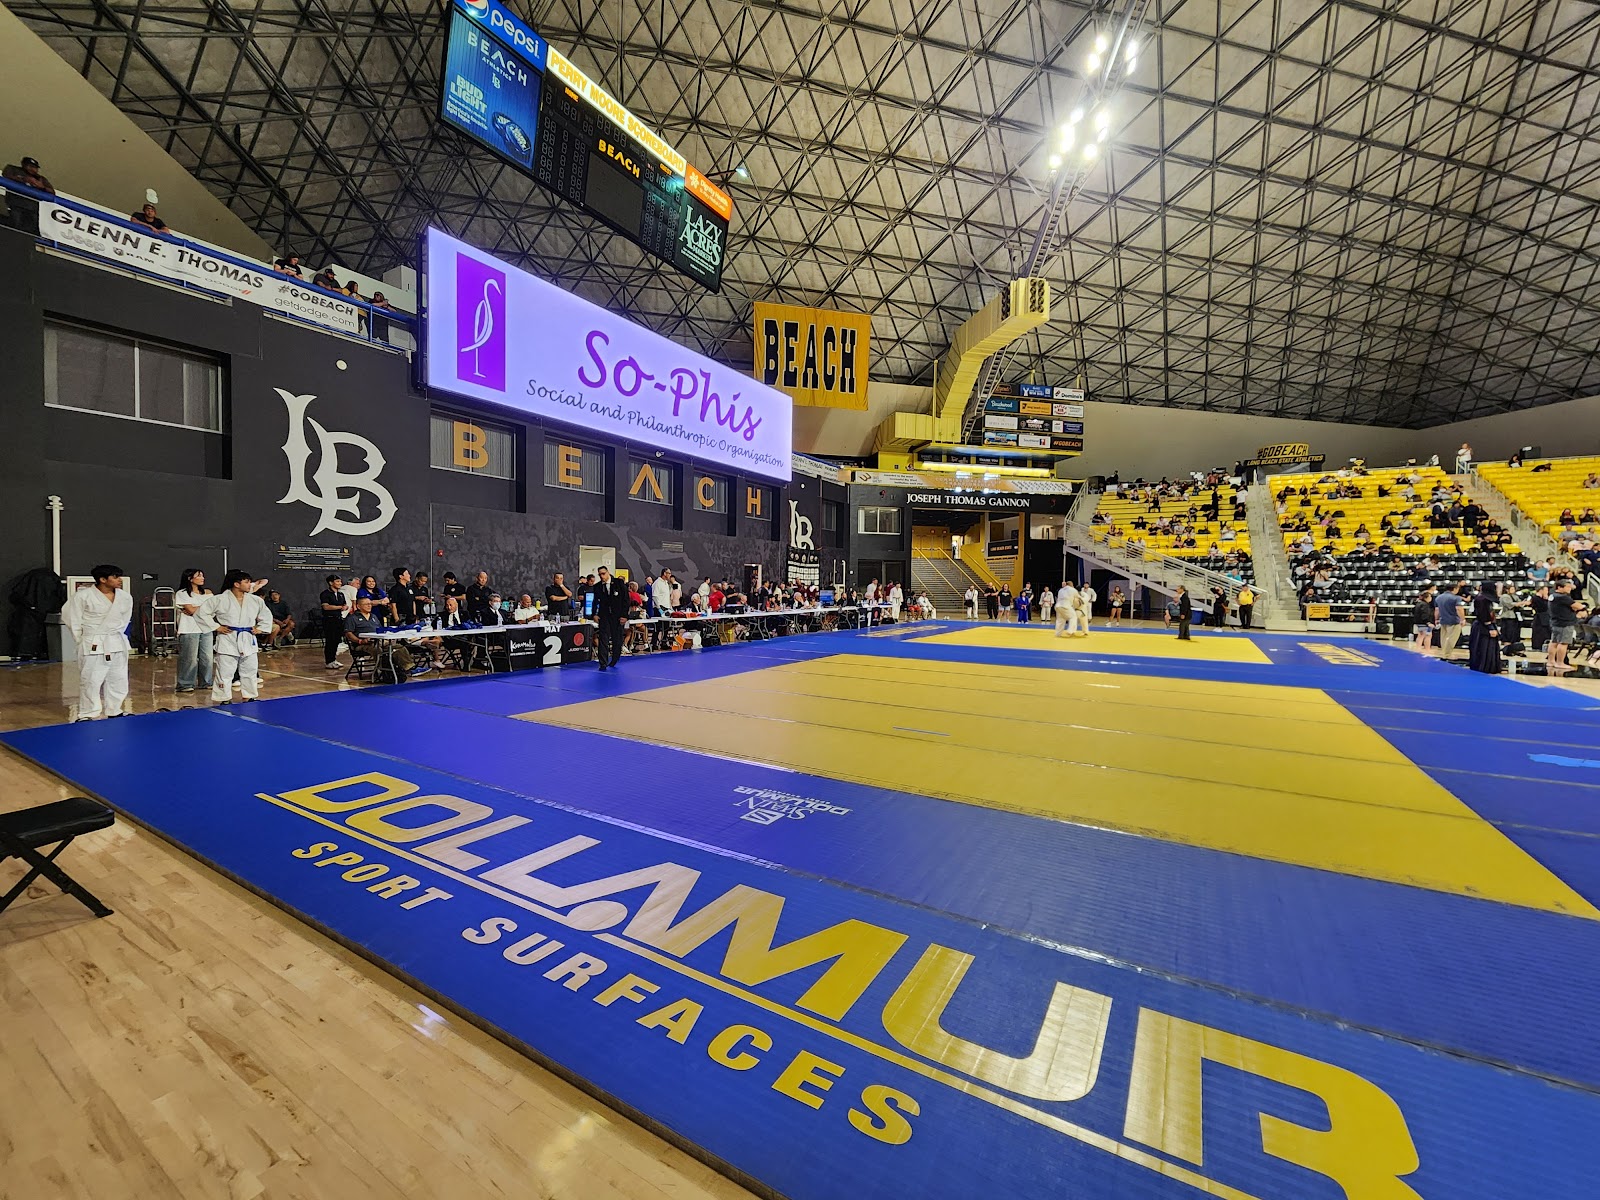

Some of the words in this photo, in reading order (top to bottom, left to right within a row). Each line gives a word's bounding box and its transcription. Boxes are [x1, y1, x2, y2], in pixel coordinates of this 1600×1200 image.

[491, 9, 538, 57] pepsi
[467, 31, 527, 86] BEACH
[482, 56, 512, 81] ATHLETICS
[450, 81, 488, 113] LIGHT
[456, 75, 484, 101] BUD
[550, 51, 588, 93] PERRY
[590, 84, 626, 124] MOORE
[627, 115, 684, 173] SCOREBOARD
[598, 139, 641, 178] BEACH
[61, 228, 106, 252] Jeep
[679, 223, 721, 265] ACRES
[685, 205, 722, 244] LAZY
[51, 209, 141, 249] GLENN
[149, 242, 166, 258] E.
[178, 250, 264, 289] THOMAS
[275, 298, 355, 328] getdodge.com
[278, 285, 354, 316] #GOBEACH
[763, 318, 858, 394] BEACH
[578, 330, 762, 441] So-Phis
[526, 379, 587, 409] Social
[590, 401, 626, 420] and
[627, 410, 717, 451] Philanthropic
[718, 440, 784, 468] Organization
[1257, 444, 1308, 459] #GOBEACH
[907, 493, 942, 504] JOSEPH
[944, 496, 986, 507] THOMAS
[988, 498, 1030, 508] GANNON
[544, 625, 561, 633] MAT
[543, 636, 562, 665] 2
[272, 771, 1424, 1200] DOLLAMUR
[291, 841, 454, 911] SPORT
[462, 917, 921, 1145] SURFACES
